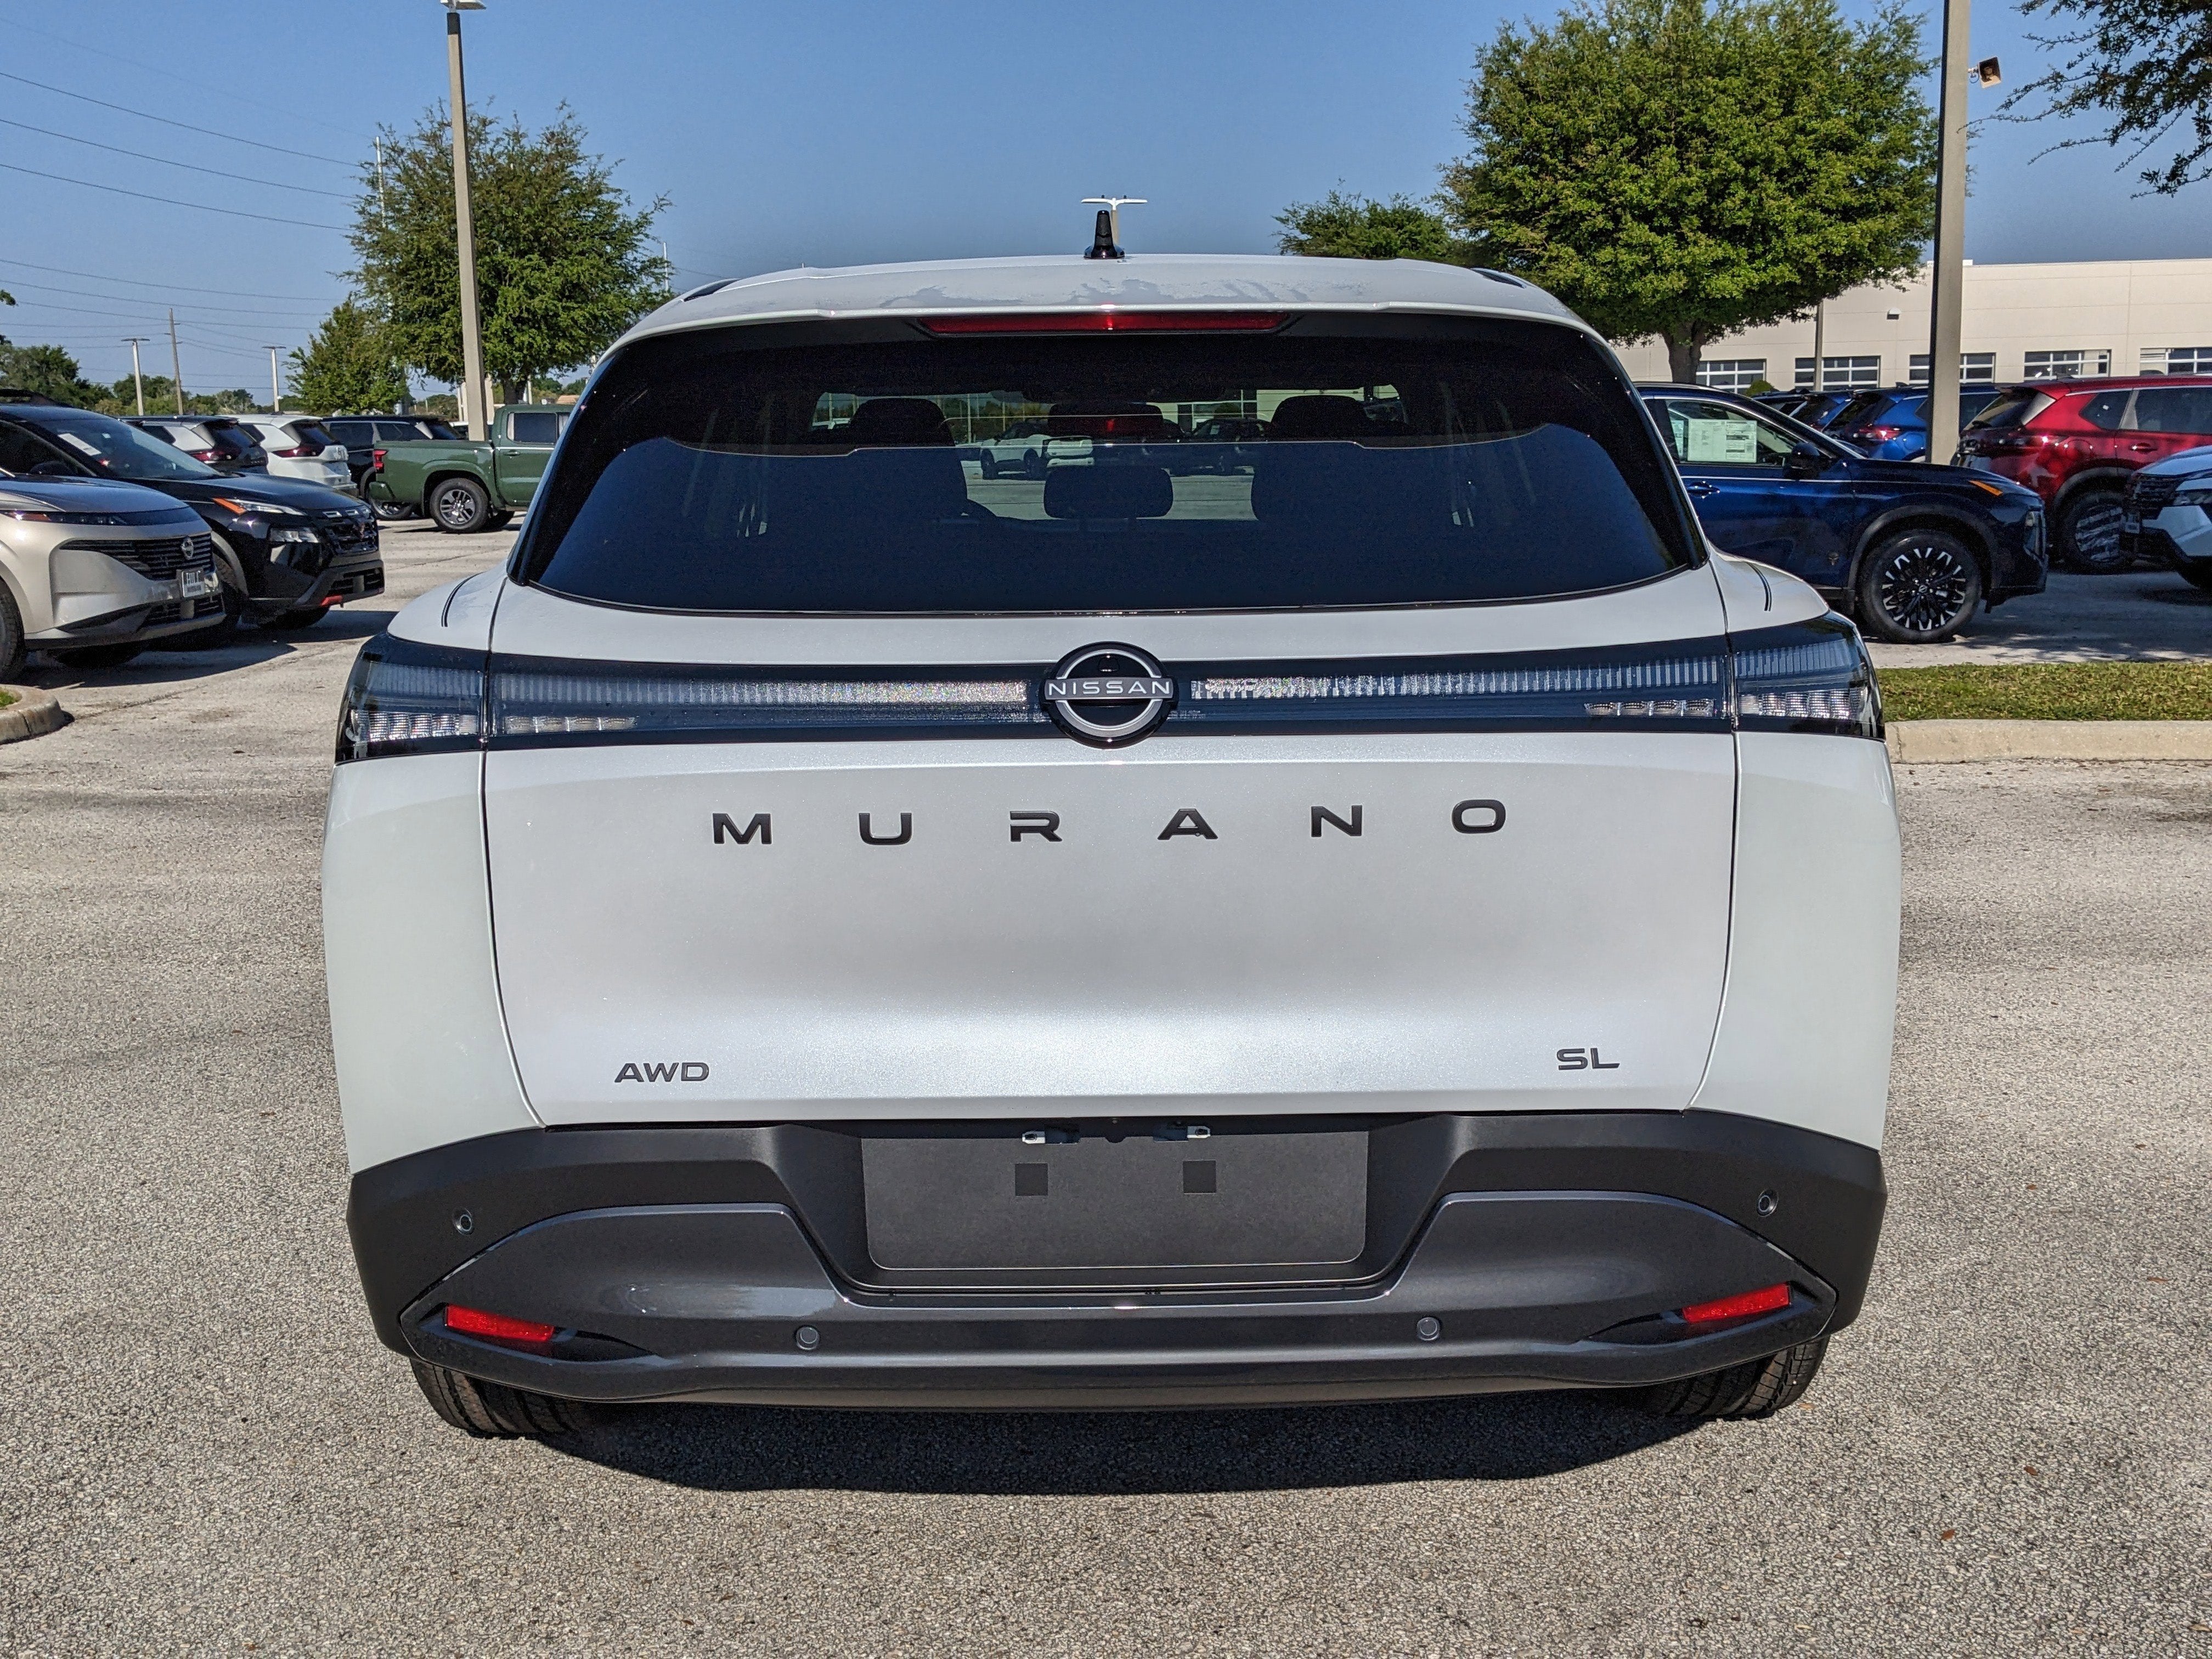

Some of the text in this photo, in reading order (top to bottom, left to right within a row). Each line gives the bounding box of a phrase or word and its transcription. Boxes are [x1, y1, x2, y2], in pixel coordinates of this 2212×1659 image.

[1048, 680, 1170, 696] NISSAN
[713, 799, 1506, 845] MURANO
[1556, 1047, 1620, 1070] SL
[614, 1062, 709, 1082] AWD
